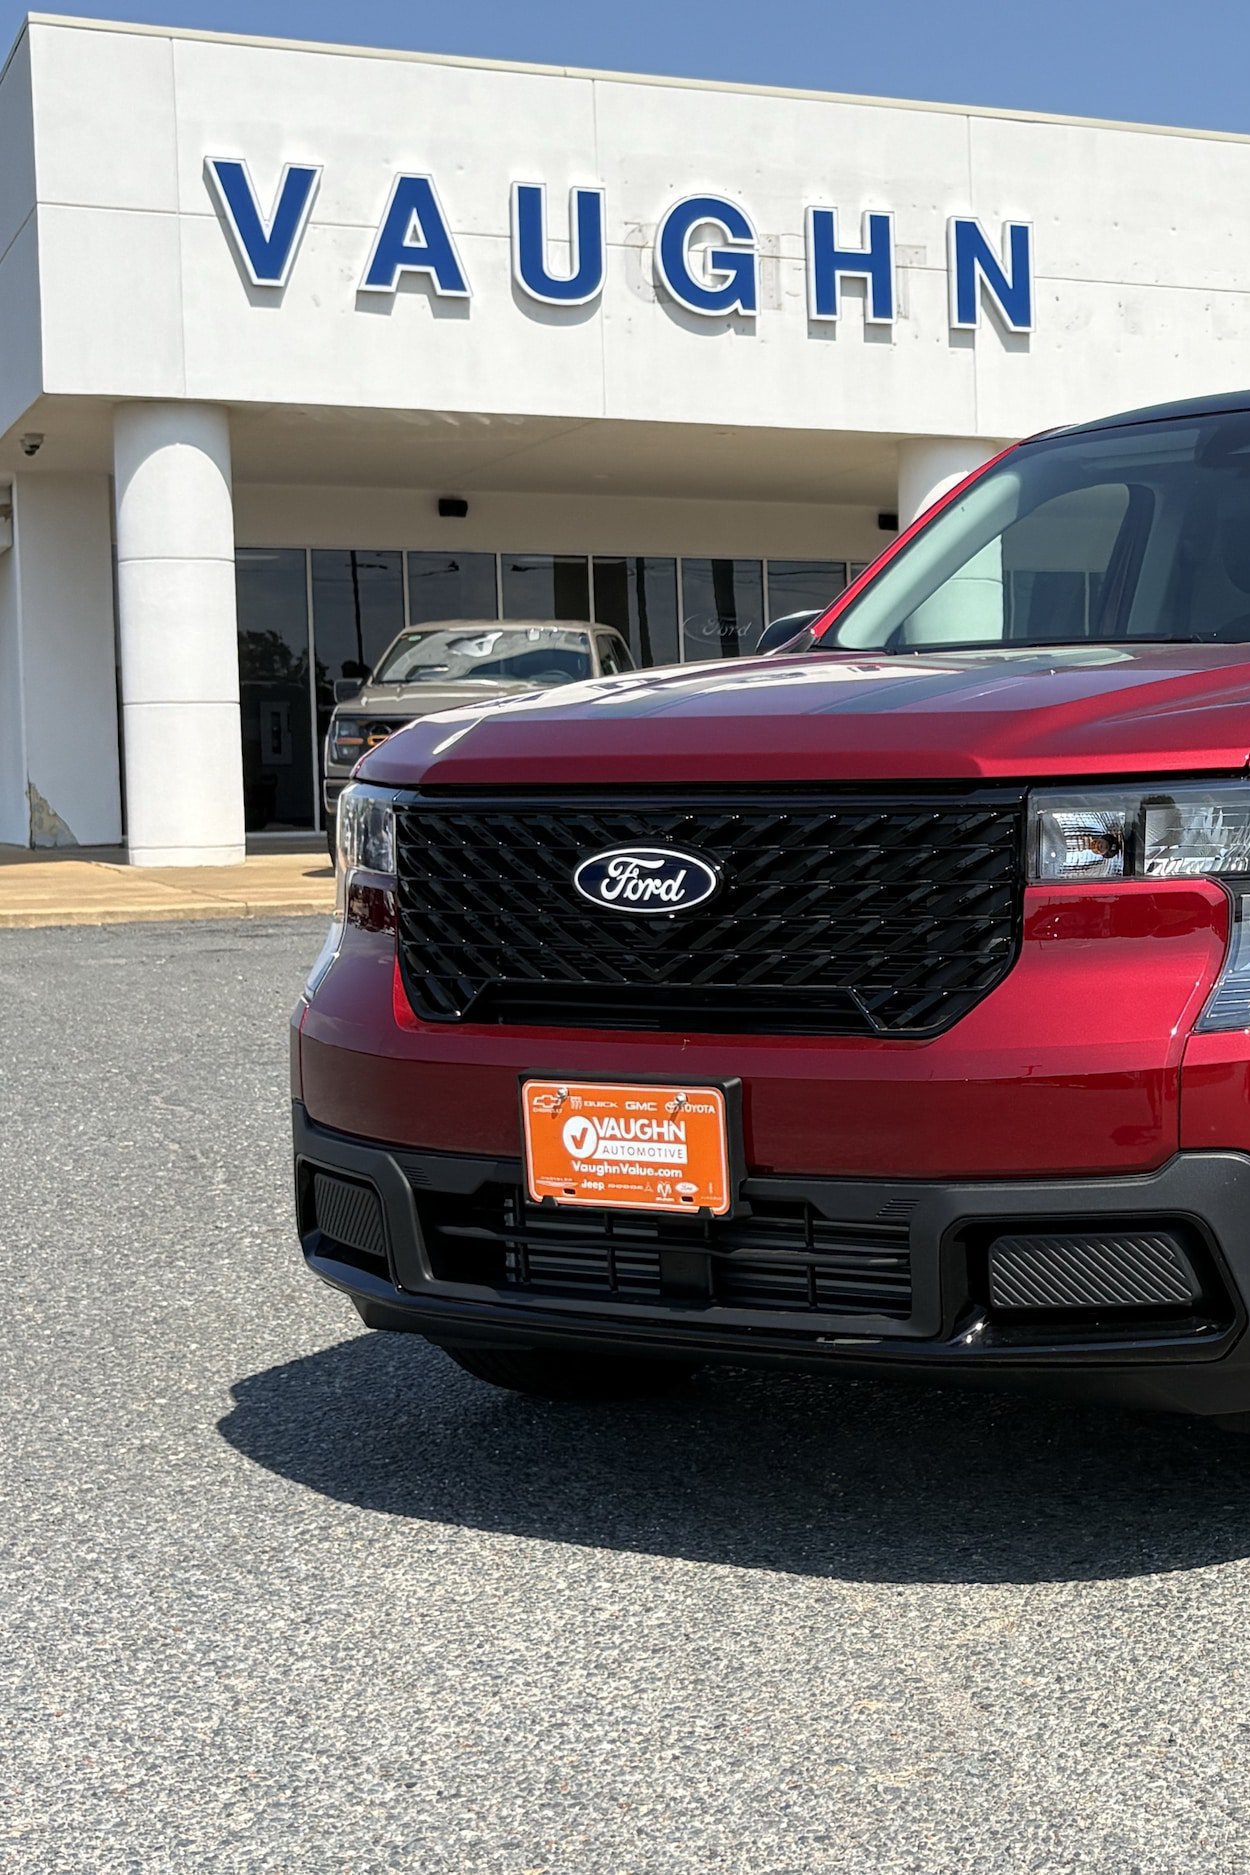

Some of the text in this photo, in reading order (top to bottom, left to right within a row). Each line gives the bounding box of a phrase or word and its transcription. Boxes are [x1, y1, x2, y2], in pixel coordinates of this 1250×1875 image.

[203, 155, 1035, 334] VAUGHN
[600, 857, 687, 902] Ford
[583, 1100, 619, 1108] BUICK
[625, 1100, 658, 1111] GMC
[592, 1116, 687, 1142] VAUGHN
[602, 1145, 684, 1159] AUTOMOTIVE
[571, 1160, 683, 1178] VaughnValue.com
[581, 1179, 606, 1191] Jeep
